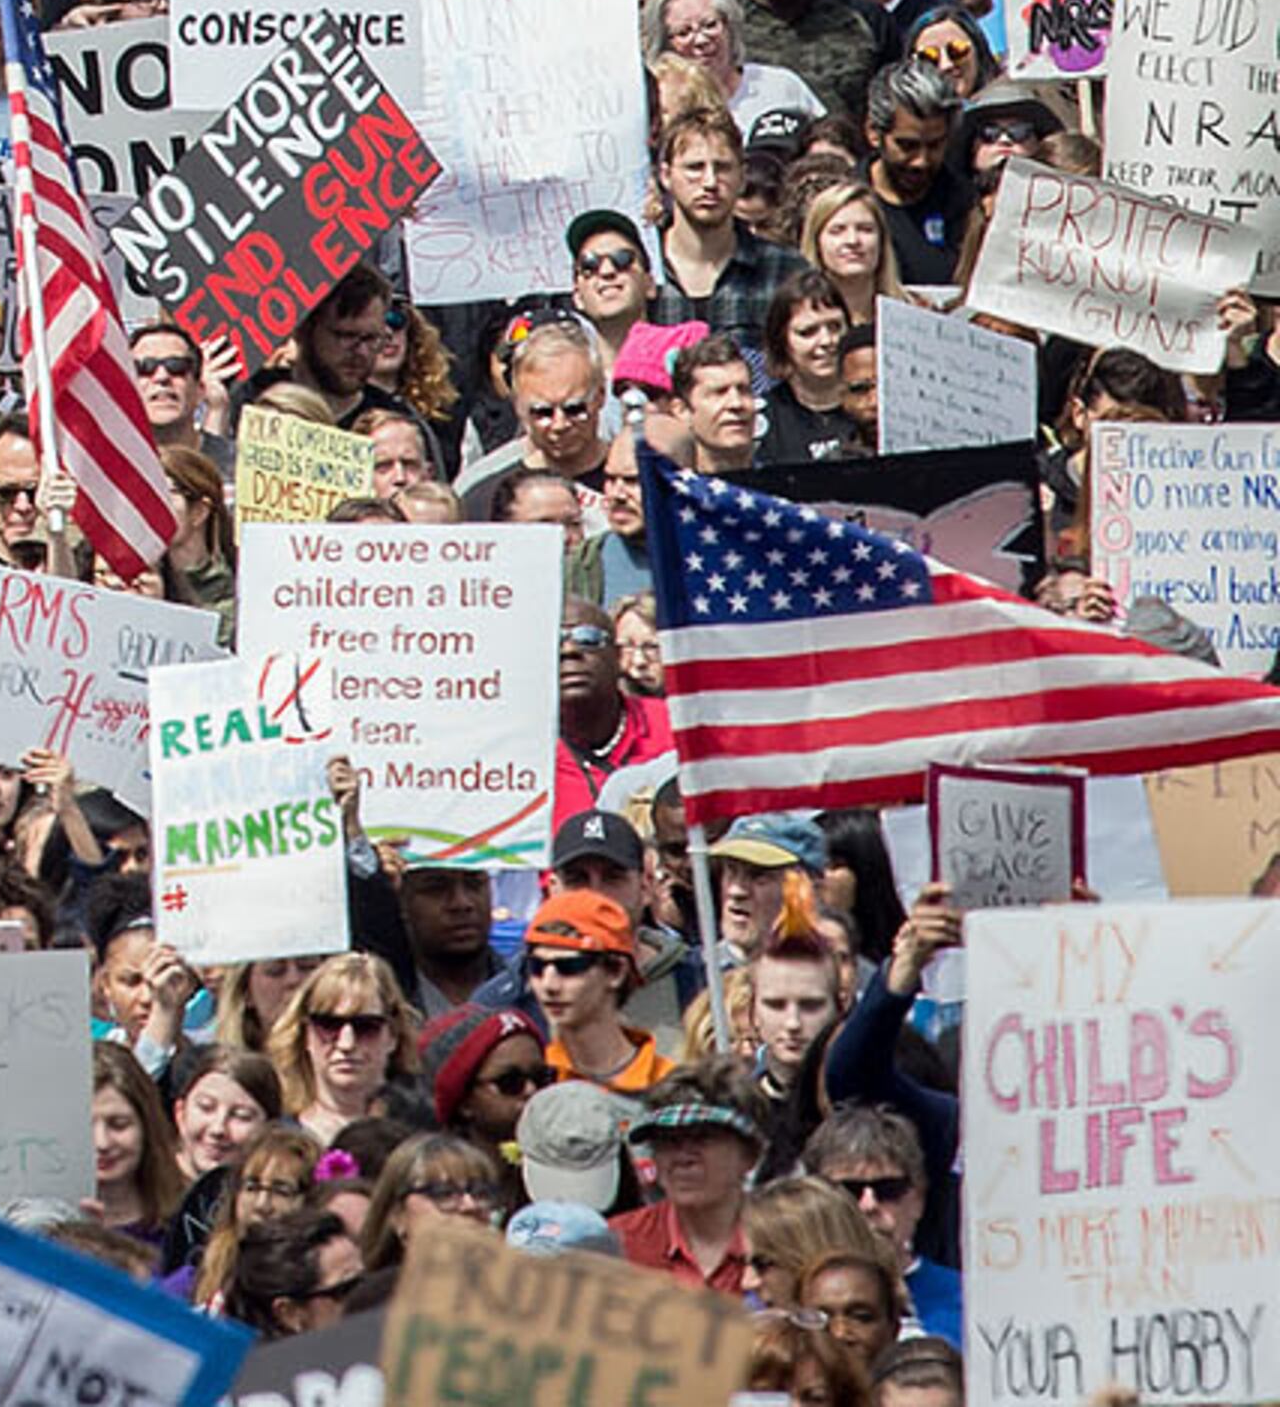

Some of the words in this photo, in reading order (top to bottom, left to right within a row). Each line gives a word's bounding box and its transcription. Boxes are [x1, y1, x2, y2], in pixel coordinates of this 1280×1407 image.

[109, 175, 194, 273] NO
[201, 17, 341, 178] MORE
[1070, 291, 1200, 355] GUNS
[289, 534, 343, 563] We
[355, 537, 428, 563] owe
[439, 537, 496, 562] our
[308, 623, 377, 652] free
[389, 624, 476, 654] from
[434, 670, 502, 700] and
[385, 761, 537, 791] Mandela
[163, 799, 339, 866] MADNESS
[957, 799, 1052, 850] GIVE
[985, 1006, 1238, 1114] CHILD'S
[1040, 1108, 1194, 1195] LIFE
[413, 1231, 732, 1367] PROTECT
[978, 1311, 1081, 1399] YOUR
[1110, 1303, 1267, 1399] HOBBY
